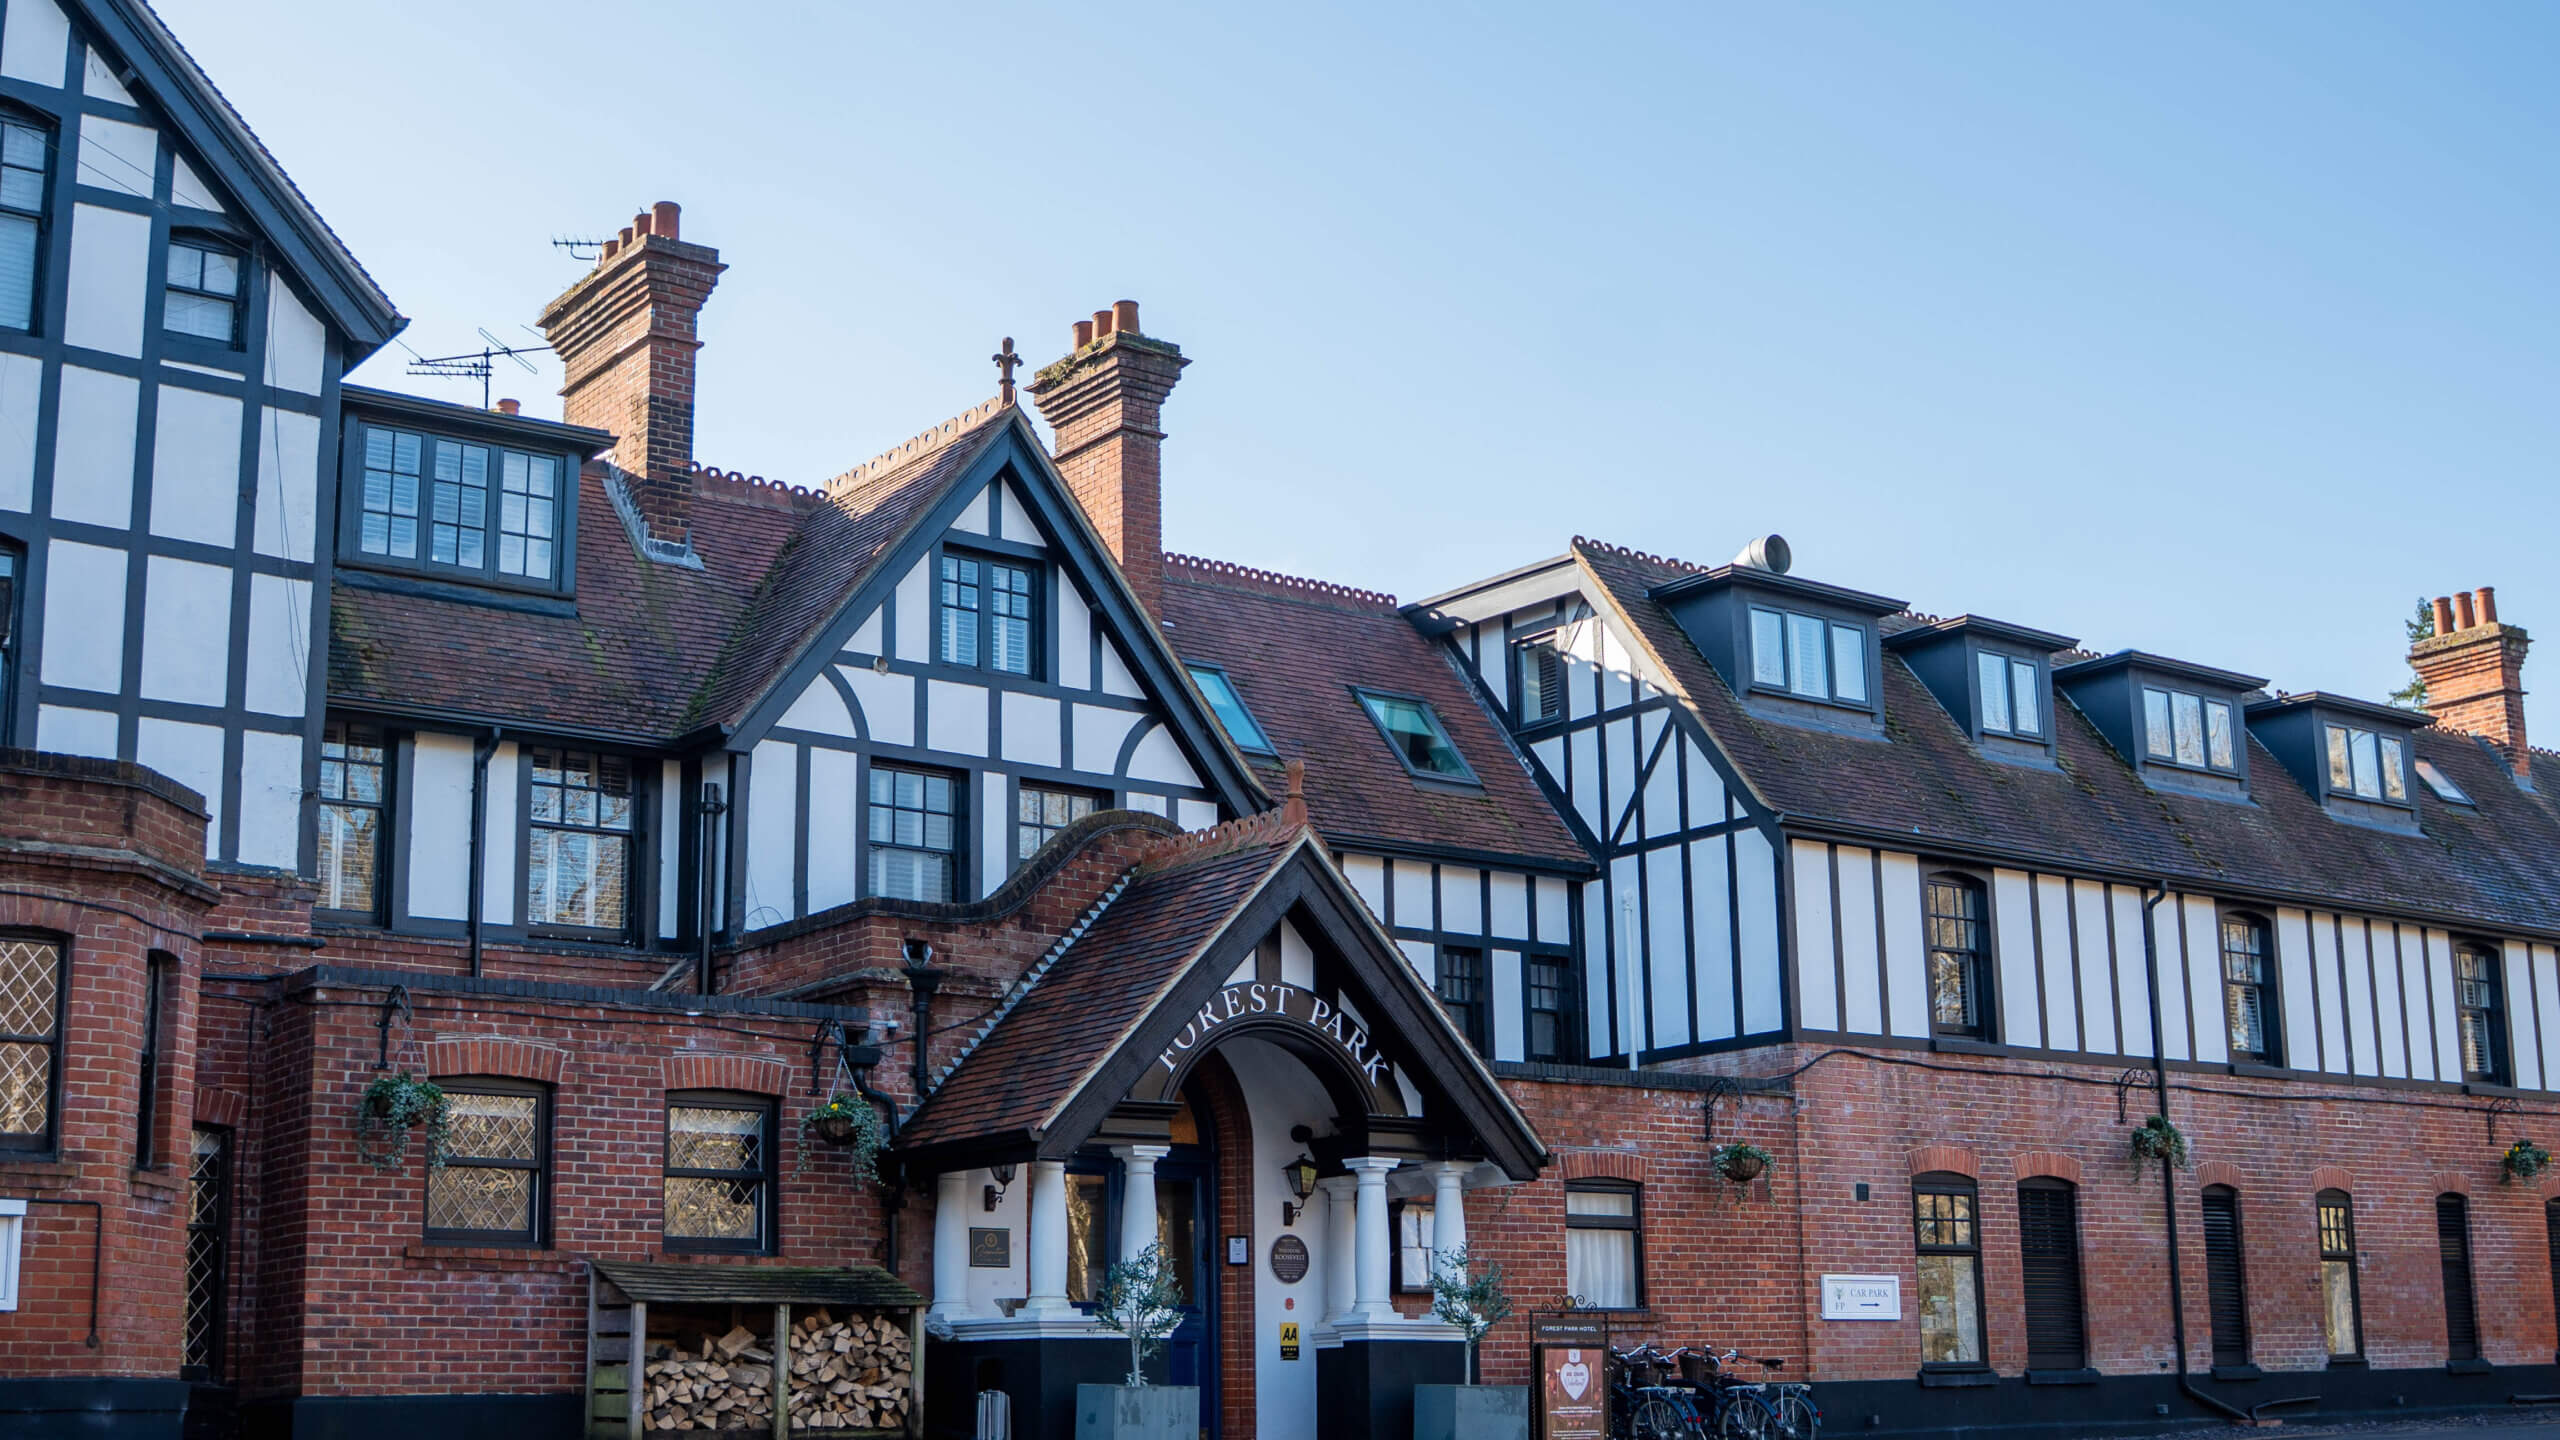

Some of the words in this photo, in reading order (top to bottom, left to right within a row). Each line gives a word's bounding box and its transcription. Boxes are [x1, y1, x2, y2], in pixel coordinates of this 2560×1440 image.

[1158, 983, 1294, 1074] FOREST
[1307, 997, 1391, 1087] PARK
[1850, 1288, 1867, 1298] CAR
[1868, 1288, 1889, 1298] PARK
[1282, 1327, 1297, 1341] AA
